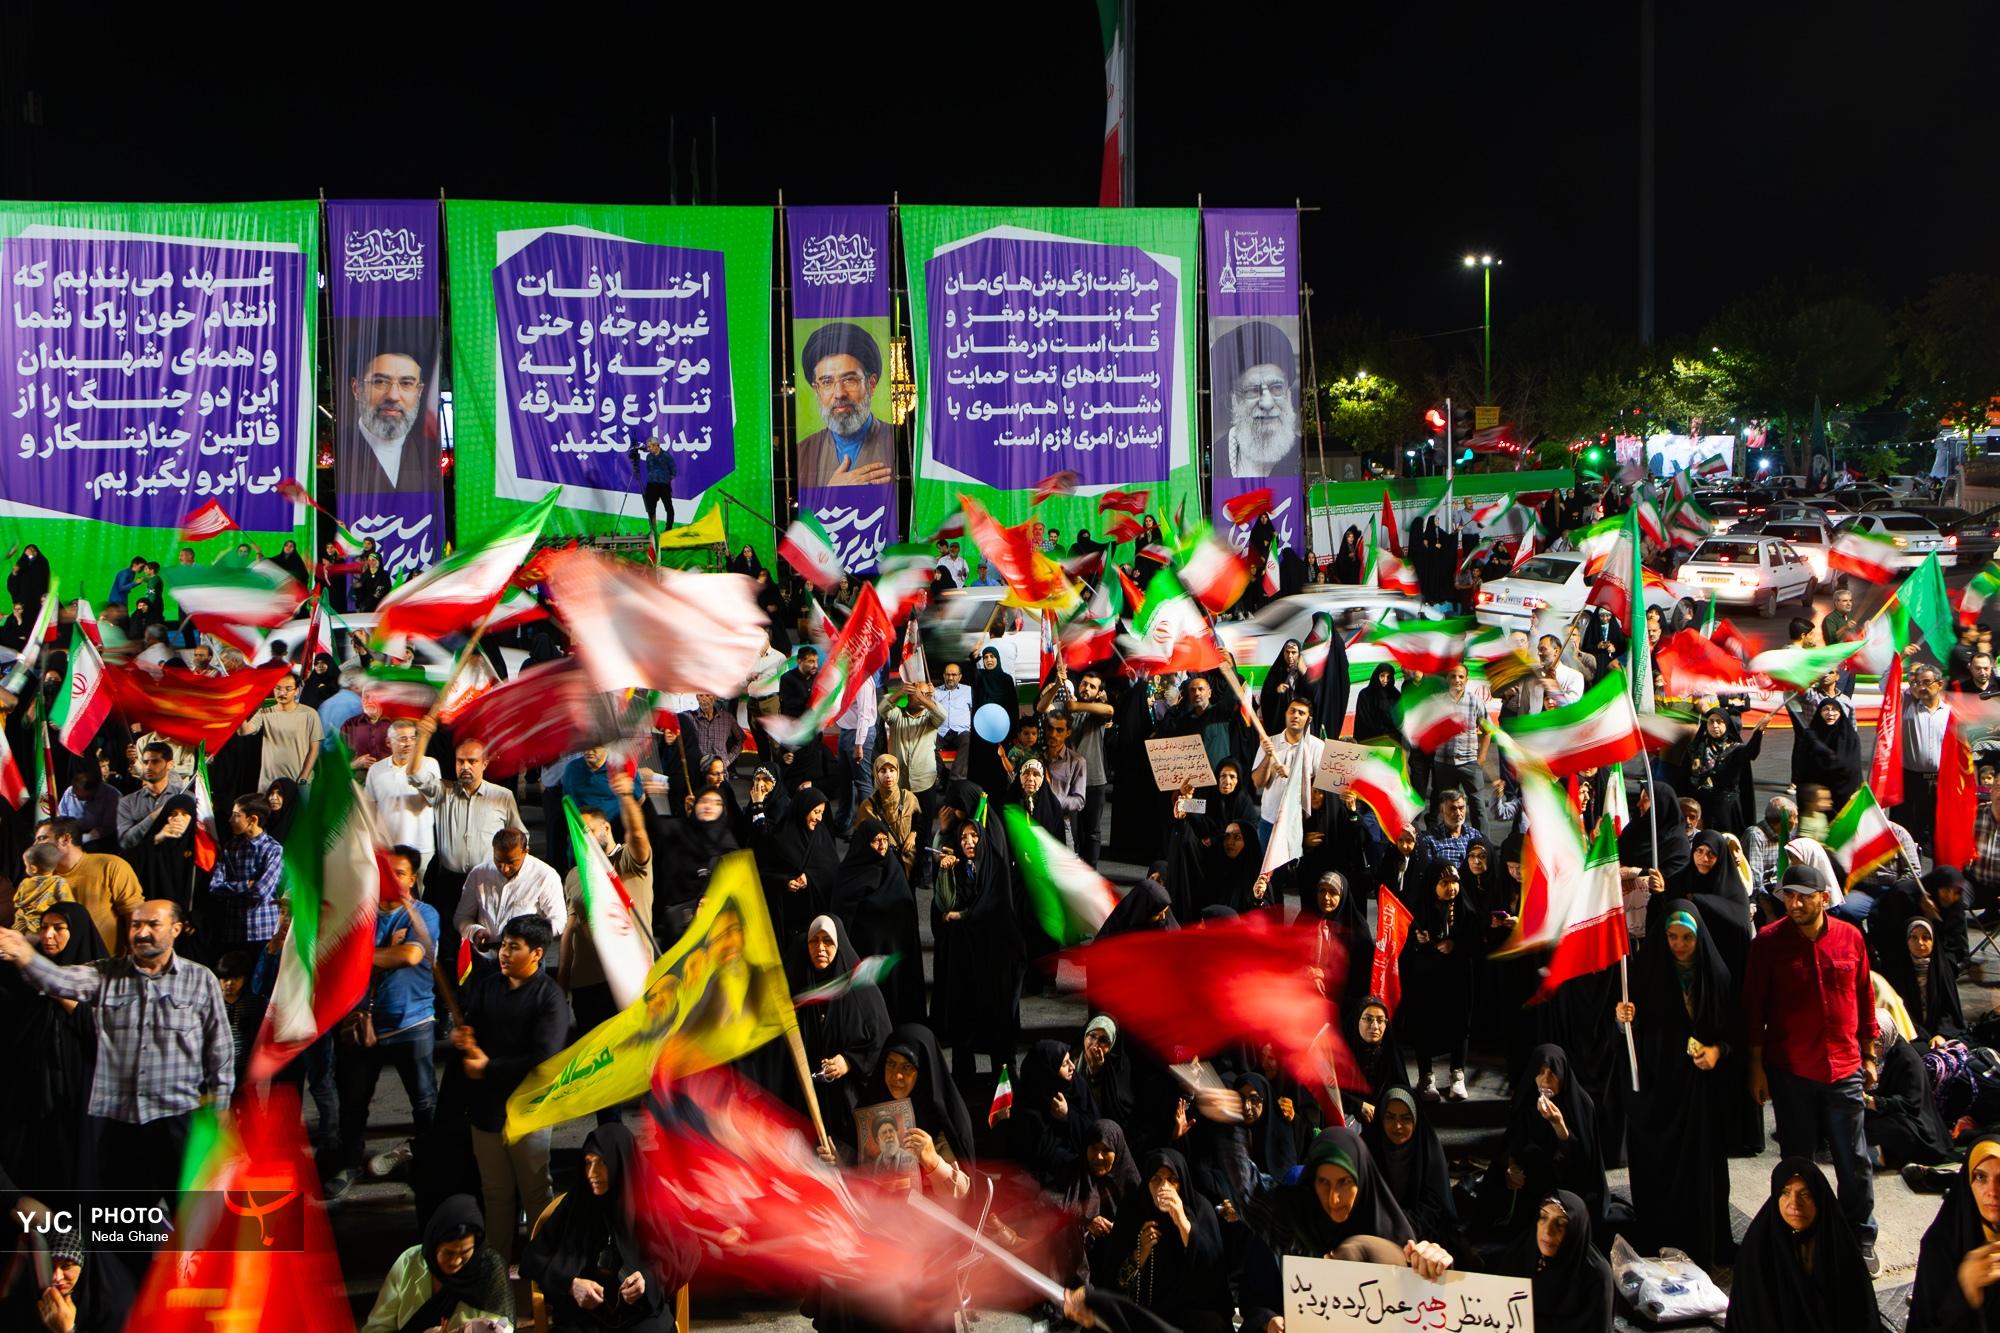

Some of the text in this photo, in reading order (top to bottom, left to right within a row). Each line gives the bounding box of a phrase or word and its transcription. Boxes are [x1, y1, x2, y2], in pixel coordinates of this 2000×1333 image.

[13, 259, 49, 288] که
[182, 267, 275, 297] عهد
[516, 265, 711, 299] اختلافات
[1077, 271, 1093, 297] از
[1093, 266, 1160, 298] مراقبت
[13, 298, 277, 342] انتقام خون پاک شما
[516, 313, 574, 345] حتی
[945, 302, 1162, 331] که پنجره مغز و
[577, 319, 594, 346] و
[946, 329, 1160, 359] قلب است در مقابل
[16, 341, 164, 377] شهیدان
[260, 348, 278, 375] و
[517, 350, 577, 385] به
[583, 348, 601, 385] را
[1013, 365, 1058, 384] تحت
[947, 365, 1009, 390] حمایت
[11, 378, 279, 419] این دو جنگ را از
[518, 379, 712, 426] تنازع و تفرقه
[947, 396, 961, 421] با
[1062, 395, 1076, 420] یا
[1080, 394, 1162, 421] دشمن
[18, 412, 280, 461] قاتلین جنایتکار و
[550, 425, 631, 460] نکنید.
[993, 424, 1163, 453] ایشان امری لازم است.
[85, 457, 191, 500] بگیریم.
[1290, 1274, 1529, 1333] اگر به نظر رهبر عمل کرده بودید
